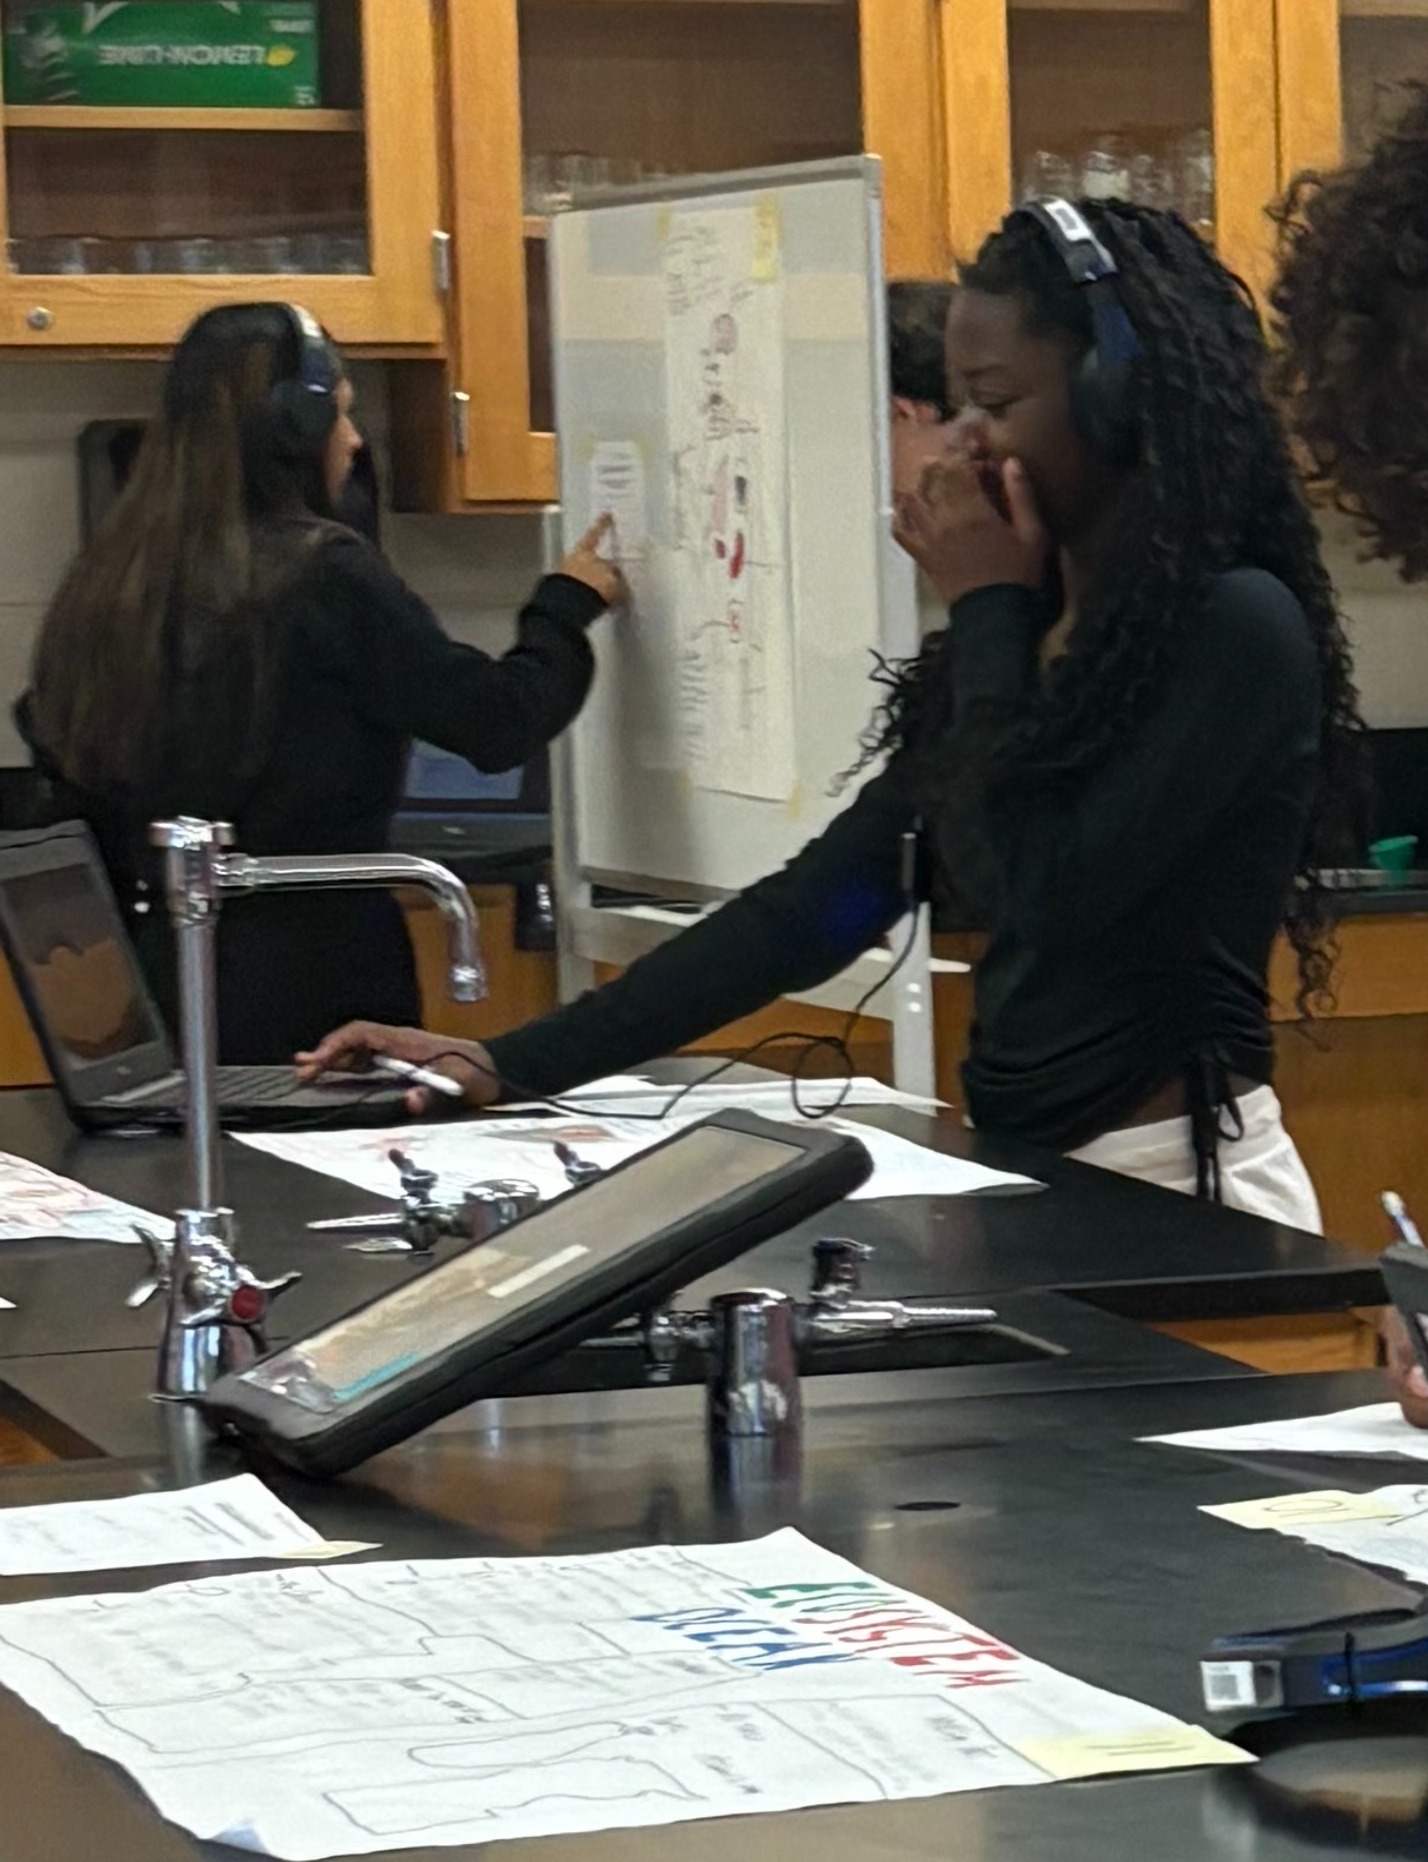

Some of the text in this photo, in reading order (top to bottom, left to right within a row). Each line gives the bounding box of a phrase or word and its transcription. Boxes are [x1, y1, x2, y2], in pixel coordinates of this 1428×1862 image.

[98, 45, 266, 65] LEMON-LIME
[628, 1607, 868, 1671] OCEAN
[735, 1581, 1030, 1688] ECOSYSTEM
